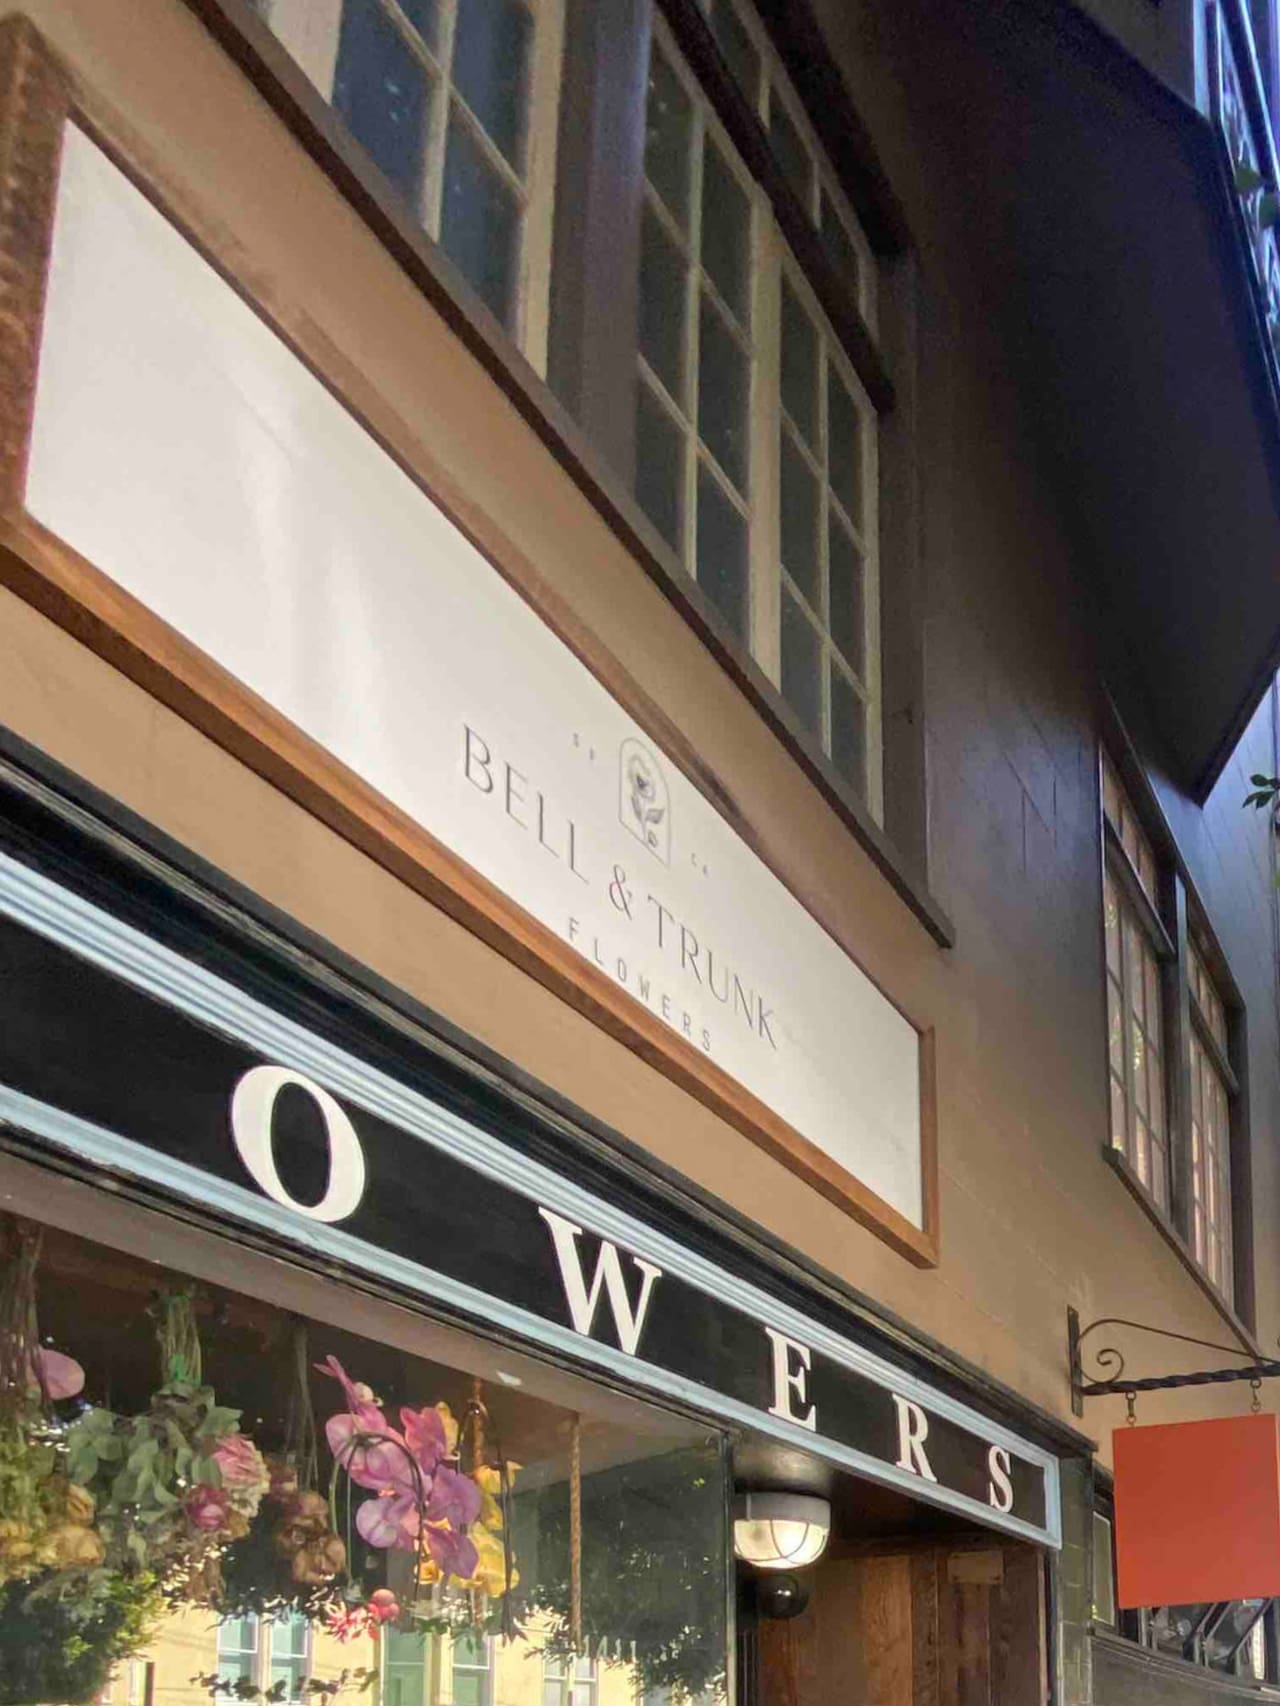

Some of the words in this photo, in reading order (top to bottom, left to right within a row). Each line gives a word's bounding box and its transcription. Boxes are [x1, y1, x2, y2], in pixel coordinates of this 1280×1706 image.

[463, 723, 590, 884] BELL
[609, 864, 632, 921] &
[647, 894, 777, 1051] TRUNK
[569, 917, 711, 1051] FLOWERS
